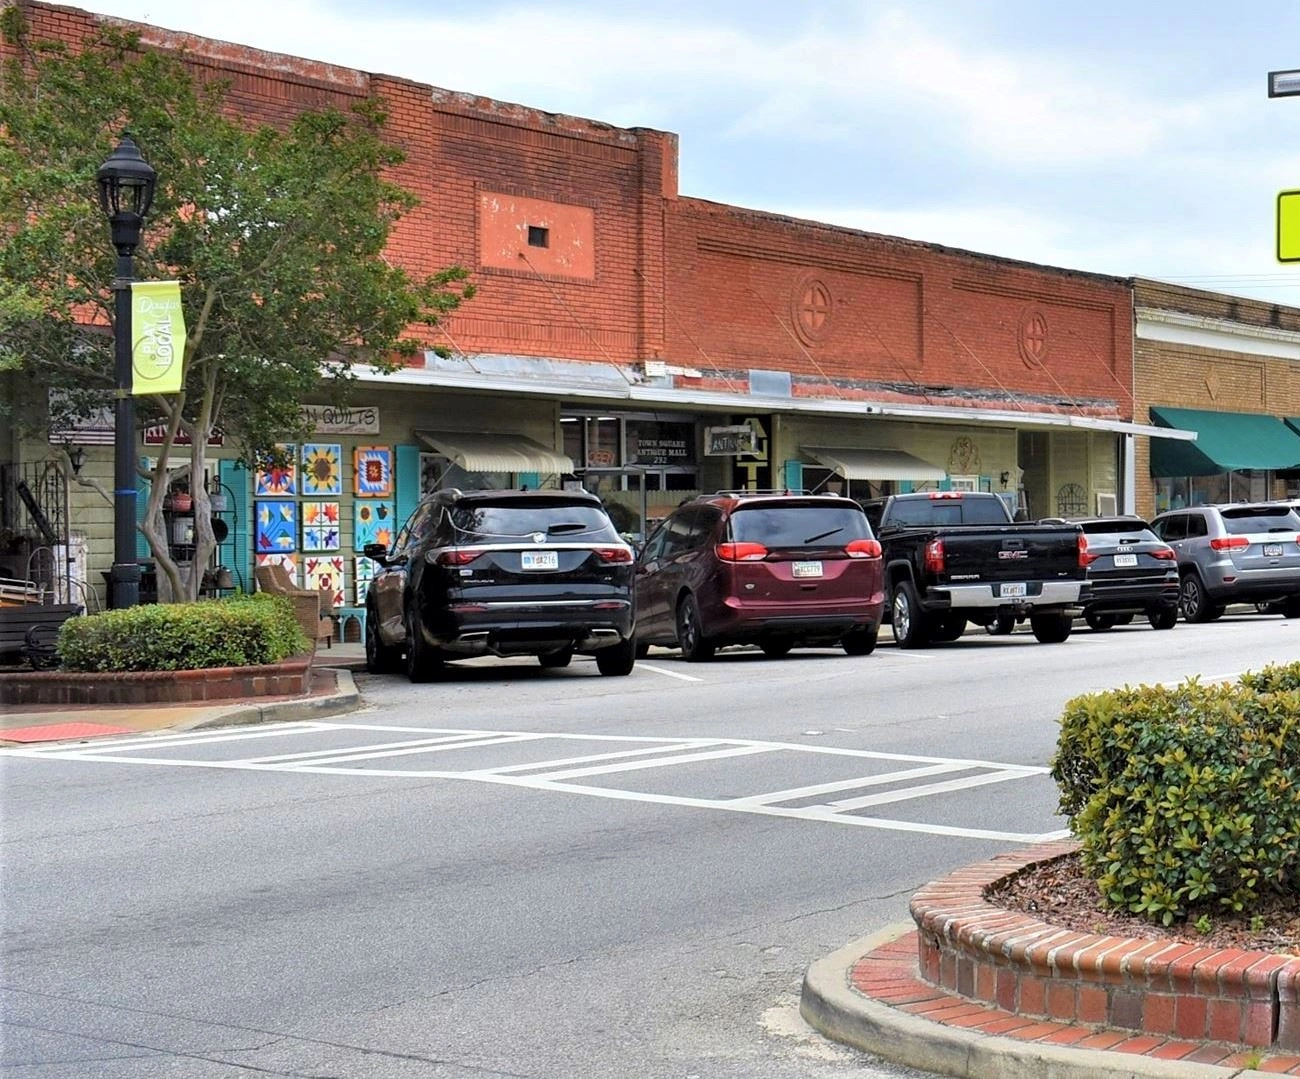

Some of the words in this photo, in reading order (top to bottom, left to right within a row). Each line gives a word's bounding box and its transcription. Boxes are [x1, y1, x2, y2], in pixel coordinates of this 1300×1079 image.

[143, 321, 155, 356] PLAY
[156, 315, 171, 367] LOCAL
[322, 408, 376, 425] QUILTS
[659, 440, 686, 448] SQUARE
[668, 449, 688, 457] MALL
[653, 456, 668, 464] 292
[998, 550, 1028, 559] GMC
